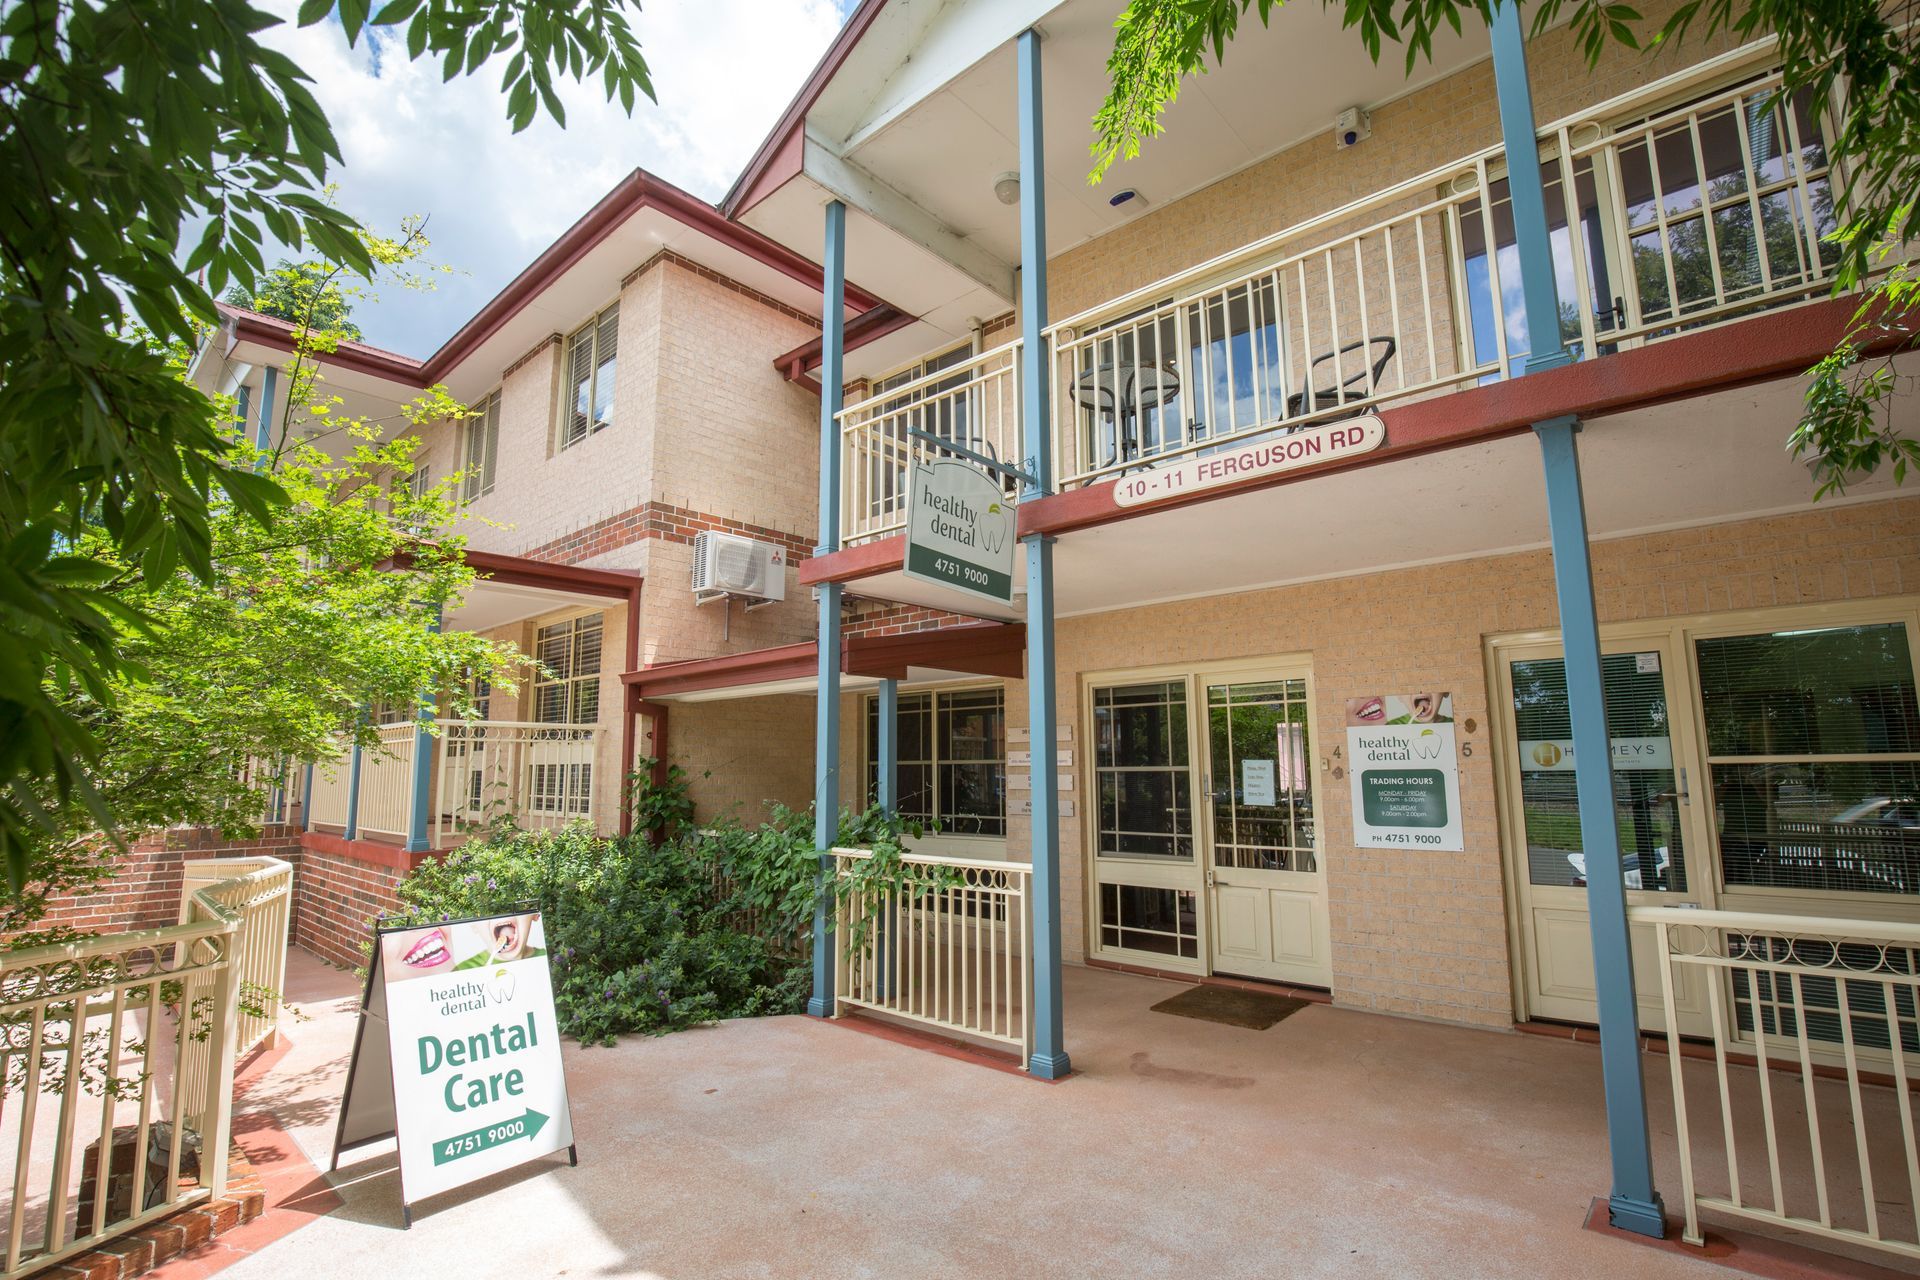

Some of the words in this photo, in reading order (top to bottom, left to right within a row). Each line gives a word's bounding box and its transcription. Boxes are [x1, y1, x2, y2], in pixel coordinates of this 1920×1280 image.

[1126, 480, 1146, 498] 10
[1164, 470, 1183, 489] 11
[1196, 436, 1322, 482] FERGUSON
[1329, 426, 1365, 450] RD
[923, 484, 978, 528] healthy
[930, 514, 975, 547] dental
[935, 558, 960, 577] 4751
[964, 567, 989, 585] 9000
[1333, 745, 1341, 759] 4
[1358, 736, 1410, 750] healthy
[1462, 742, 1472, 757] 5
[1367, 749, 1410, 761] dental
[1369, 777, 1404, 785] TRADING
[1406, 777, 1434, 785] HOURS
[1385, 834, 1410, 843] 4751
[1414, 834, 1442, 844] 9000
[430, 981, 485, 1003] healthy
[440, 995, 487, 1016] dental
[417, 1011, 538, 1075] Dental
[444, 1068, 524, 1113] Care
[444, 1134, 482, 1157] 4751
[488, 1120, 524, 1143] 9000
